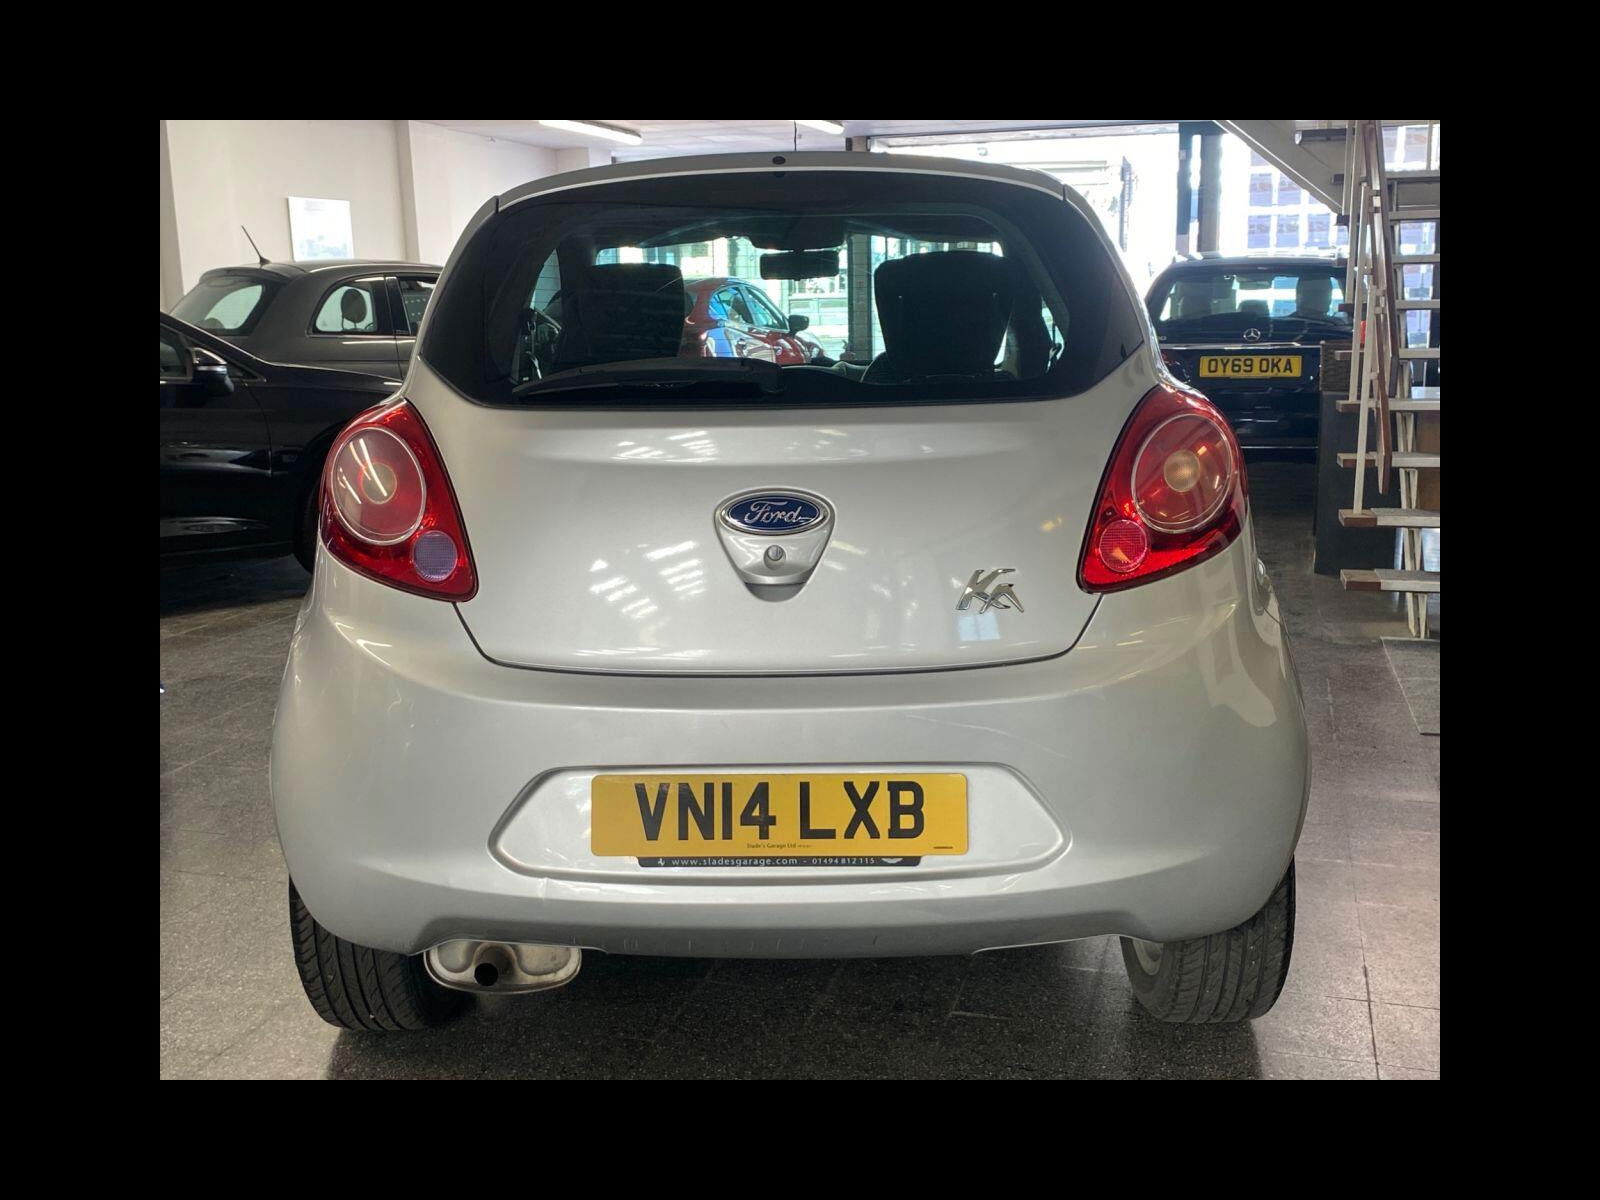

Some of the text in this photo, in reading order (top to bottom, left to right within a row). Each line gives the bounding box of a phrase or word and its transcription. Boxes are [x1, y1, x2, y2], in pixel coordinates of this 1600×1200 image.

[1208, 358, 1293, 374] OY69 OKA
[744, 501, 814, 524] Ford
[634, 781, 925, 841] VN14 LXB
[671, 856, 798, 867] www.sladesgarage.com
